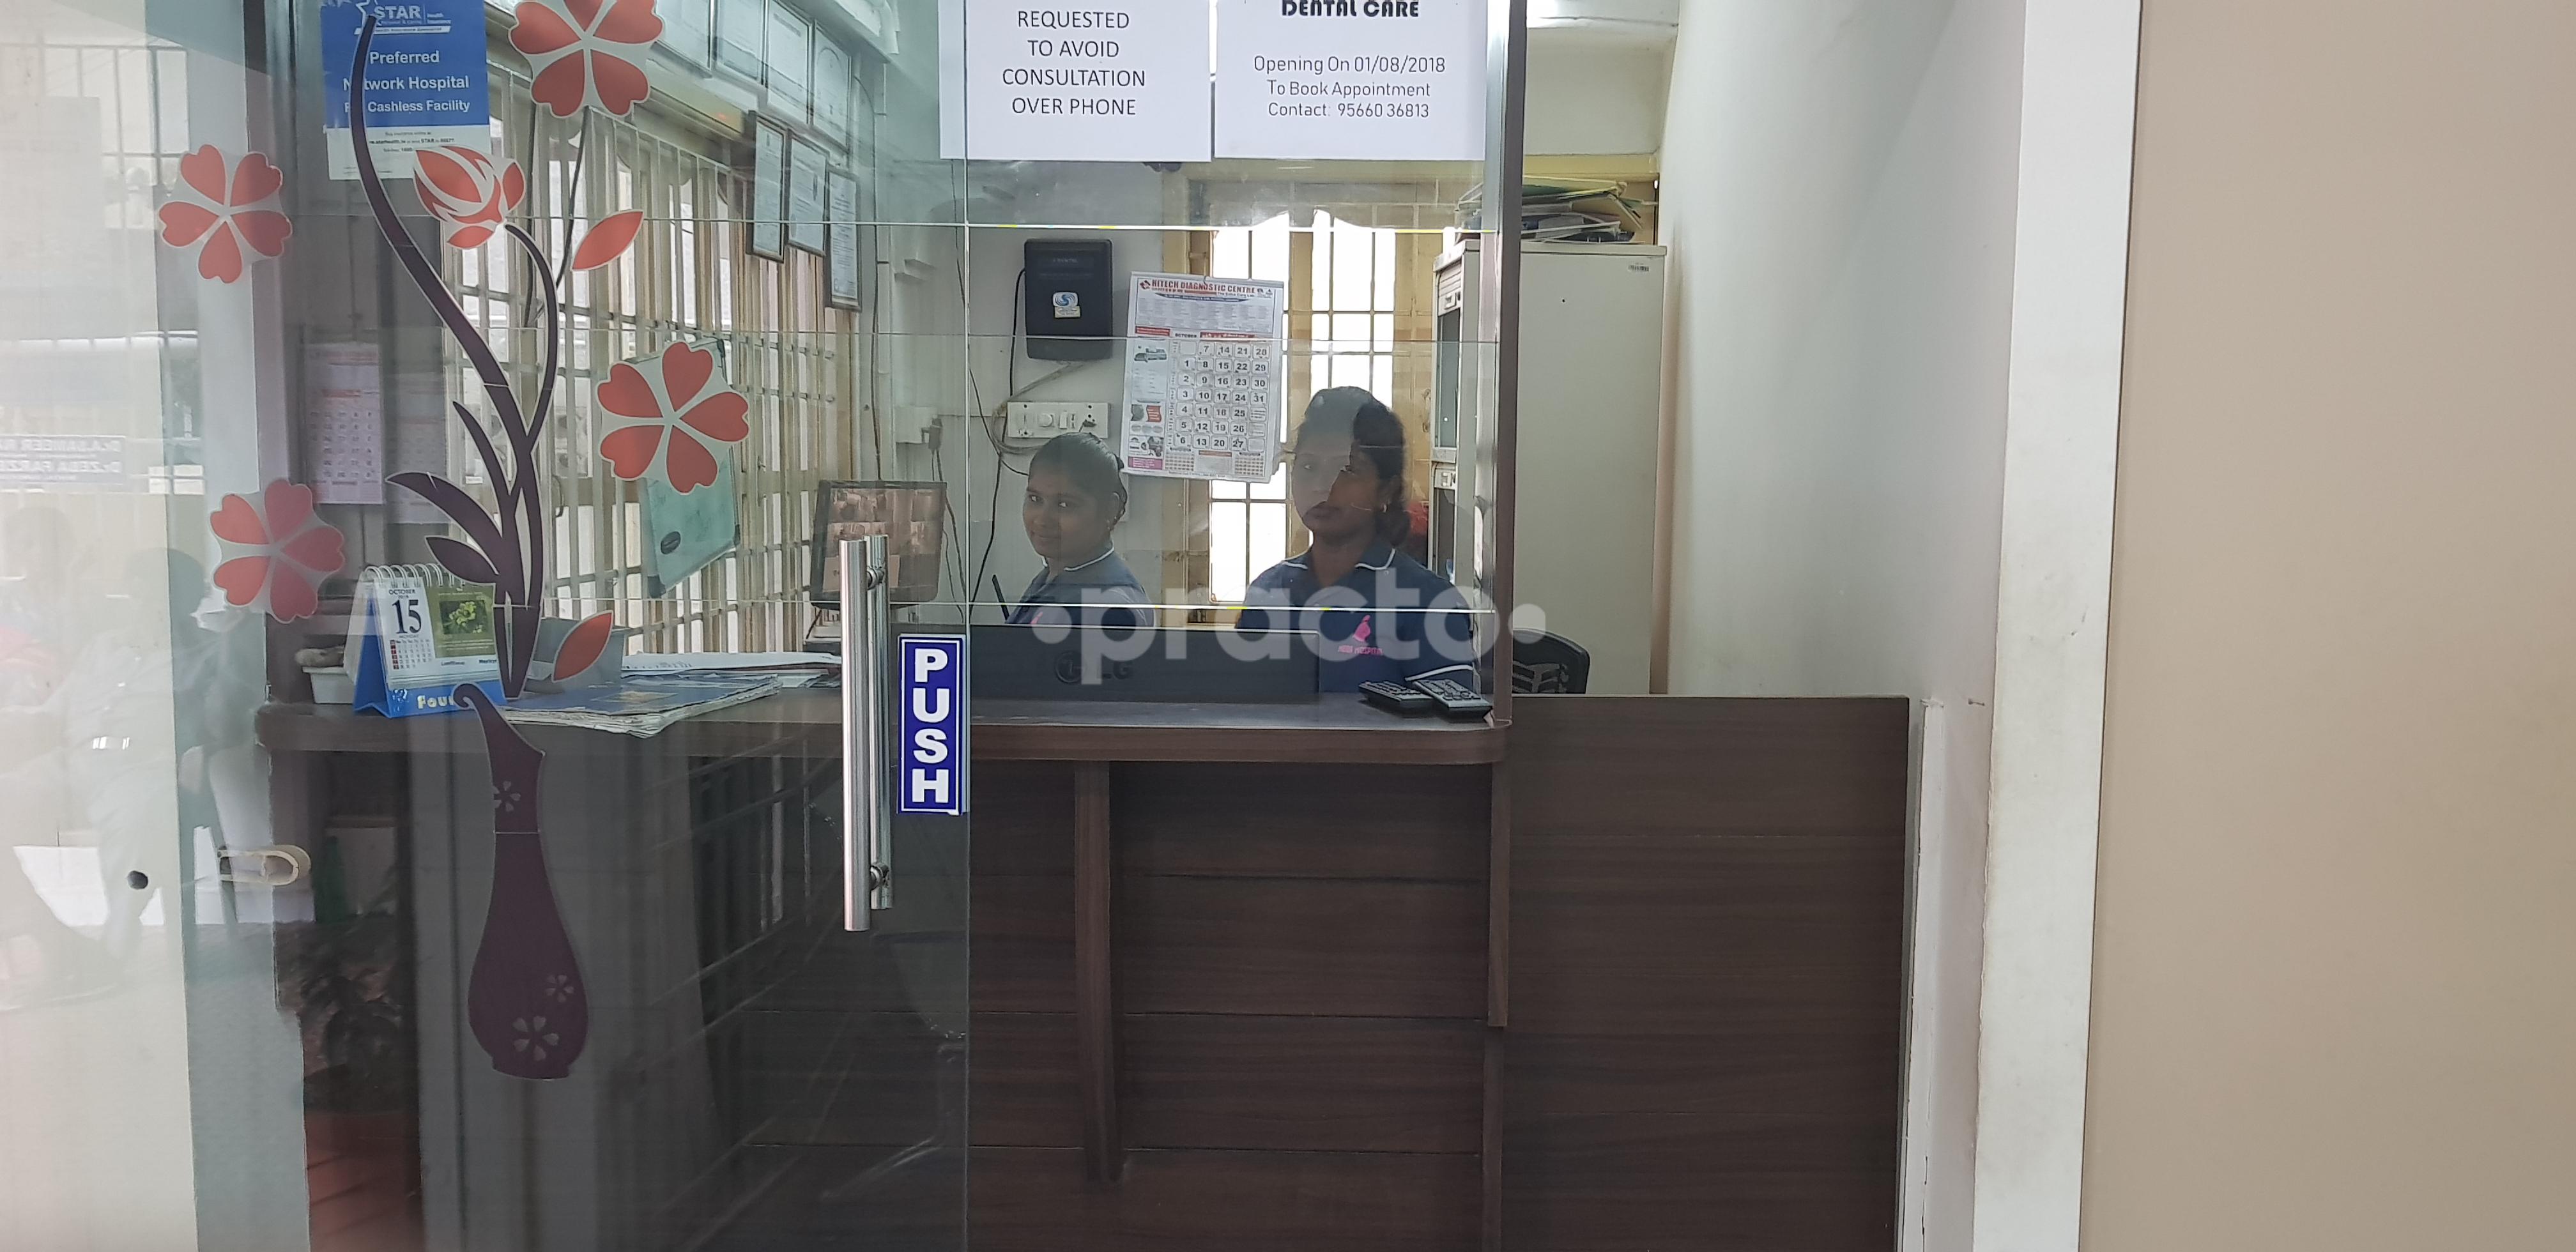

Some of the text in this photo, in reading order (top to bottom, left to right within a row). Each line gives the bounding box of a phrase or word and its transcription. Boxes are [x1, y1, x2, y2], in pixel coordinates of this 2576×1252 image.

[374, 5, 422, 19] STAR
[1282, 0, 1419, 17] DENTAL CARE
[1018, 11, 1130, 29] REQUESTED
[369, 50, 440, 63] Preferred
[1027, 40, 1119, 57] TO AVOID
[1254, 55, 1446, 75] Opening On 01/08/2018
[343, 75, 470, 91] Ntwork Hospital
[1002, 68, 1146, 86] CONSULTATION
[1267, 79, 1430, 99] To Book Appointment
[368, 101, 424, 112] Cashless
[426, 100, 470, 112] Facility
[1012, 97, 1136, 115] OVER PHONE
[1268, 102, 1429, 118] Contact: 95660 36813
[1152, 279, 1179, 288] HITECH
[1181, 281, 1225, 291] DIAGNOSTIC
[1228, 283, 1255, 293] CENTRE
[392, 599, 422, 634] 15
[912, 648, 950, 803] PUSH
